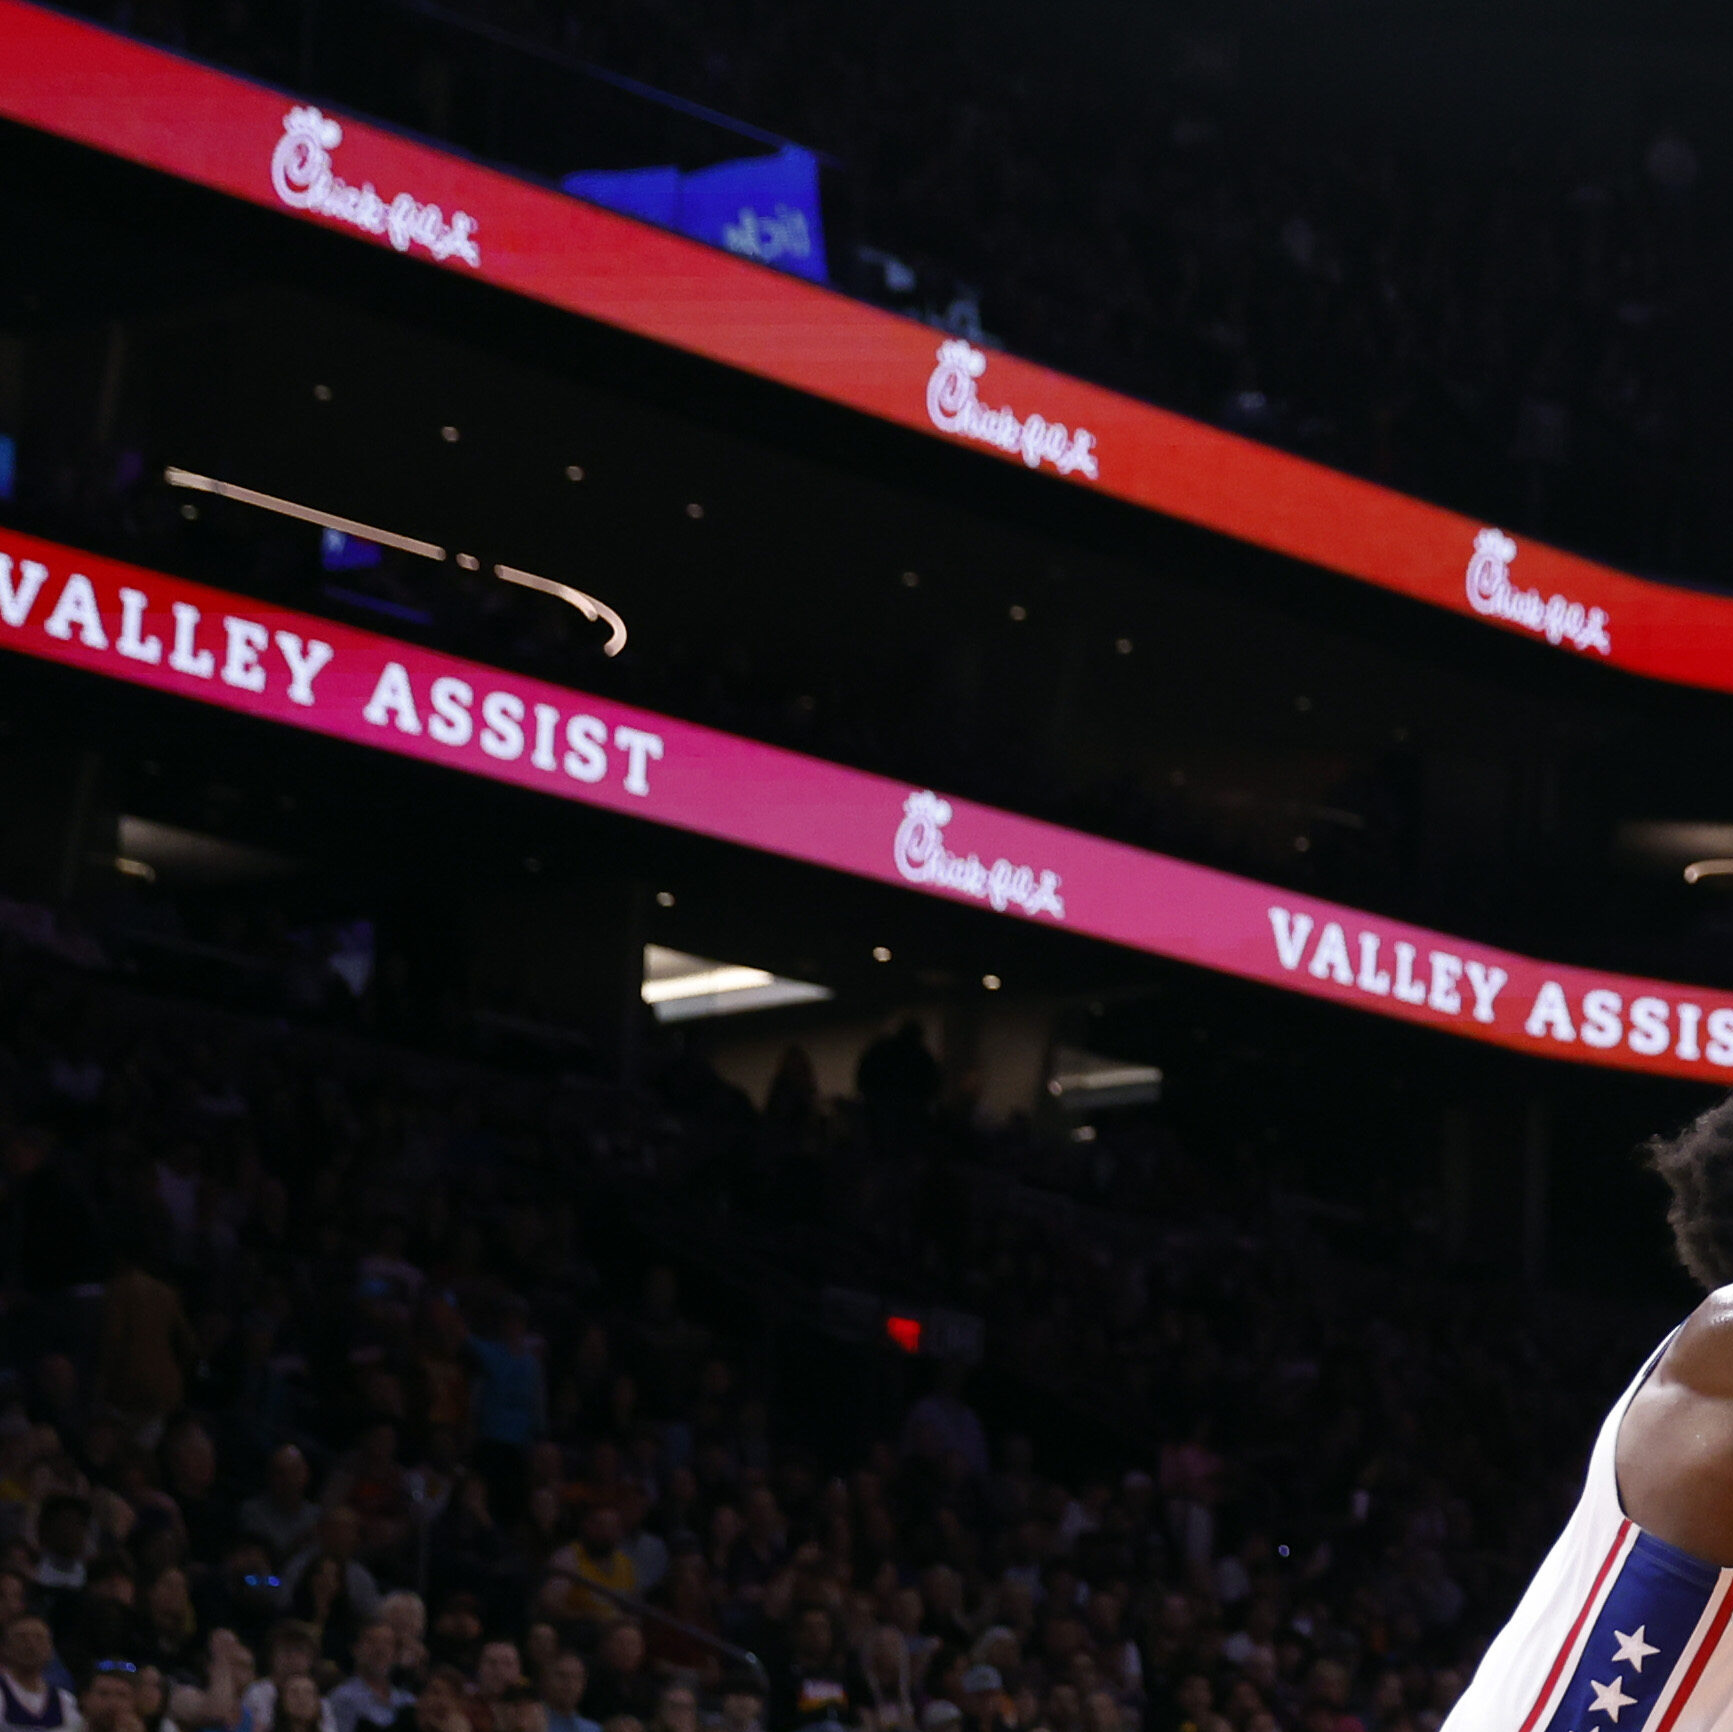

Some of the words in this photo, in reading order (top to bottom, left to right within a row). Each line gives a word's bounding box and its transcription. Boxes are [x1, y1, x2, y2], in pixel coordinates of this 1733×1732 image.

[0, 554, 333, 707] VALLEY
[363, 662, 664, 797] ASSIST
[1268, 907, 1508, 1024] VALLEY
